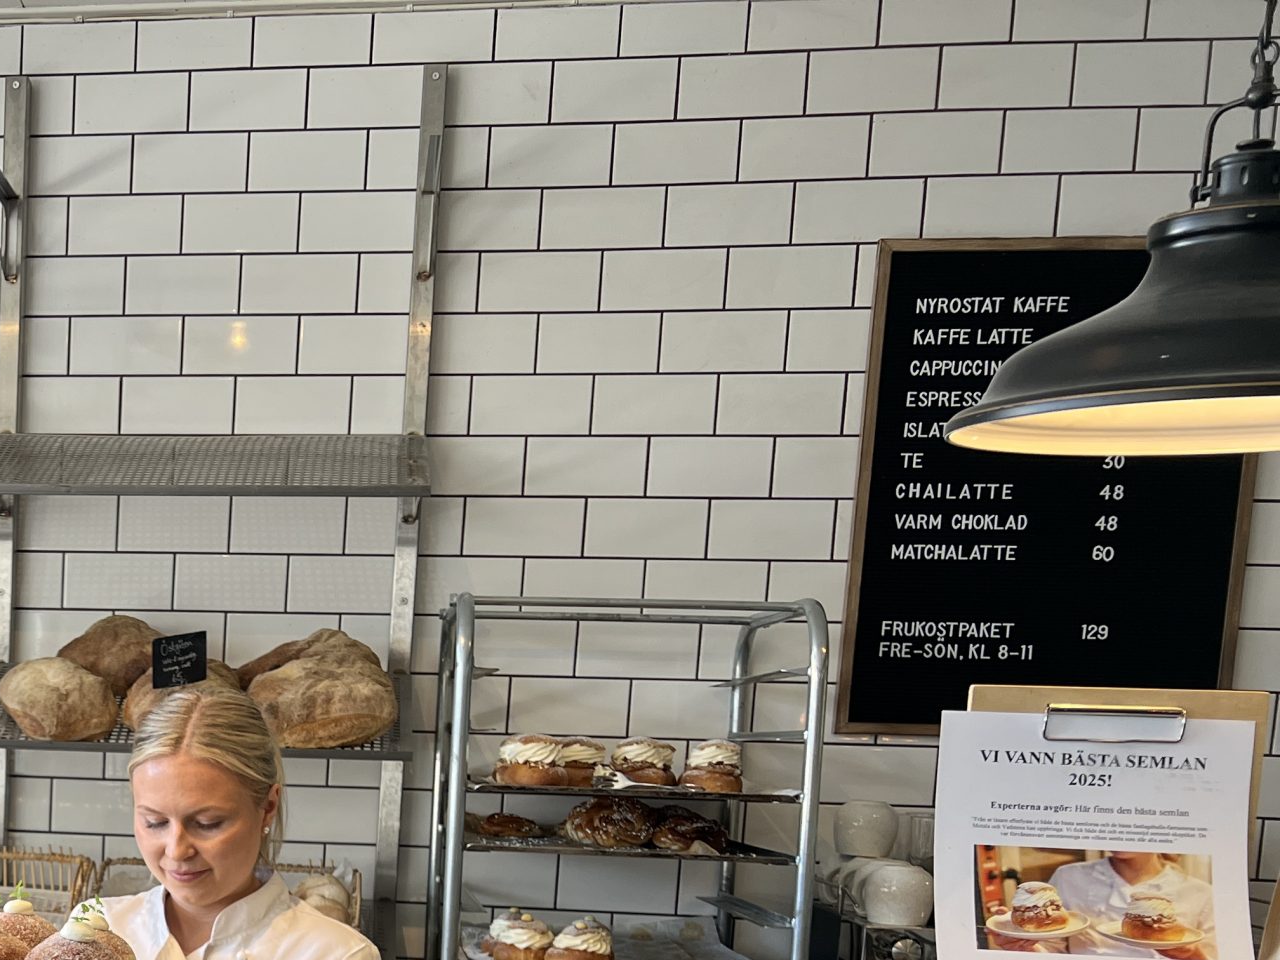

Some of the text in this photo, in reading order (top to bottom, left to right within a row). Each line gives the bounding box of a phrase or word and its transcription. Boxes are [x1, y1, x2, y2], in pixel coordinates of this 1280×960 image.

[915, 296, 1071, 314] NYROSTAT KAFFE
[912, 328, 1034, 345] KAFFE LATTE
[909, 359, 1001, 376] CAPPUCCIN
[905, 391, 982, 407] ESPRESS
[900, 452, 1125, 469] TE 30
[895, 482, 1125, 501] CHAILATTE 48
[894, 513, 1118, 532] VARM CHOKLAD 48
[890, 543, 1115, 562] MATCHALATTE 60
[881, 620, 1109, 640] FRUKOSTPAKET 129
[878, 635, 1033, 661] FRE-SÖN, KL 8-11
[980, 749, 1208, 770] VI VANN BÄSTA SEMLAN
[1068, 773, 1113, 787] 2025!
[990, 801, 1190, 817] Experterna avgör: Här finns den bästa semlan
